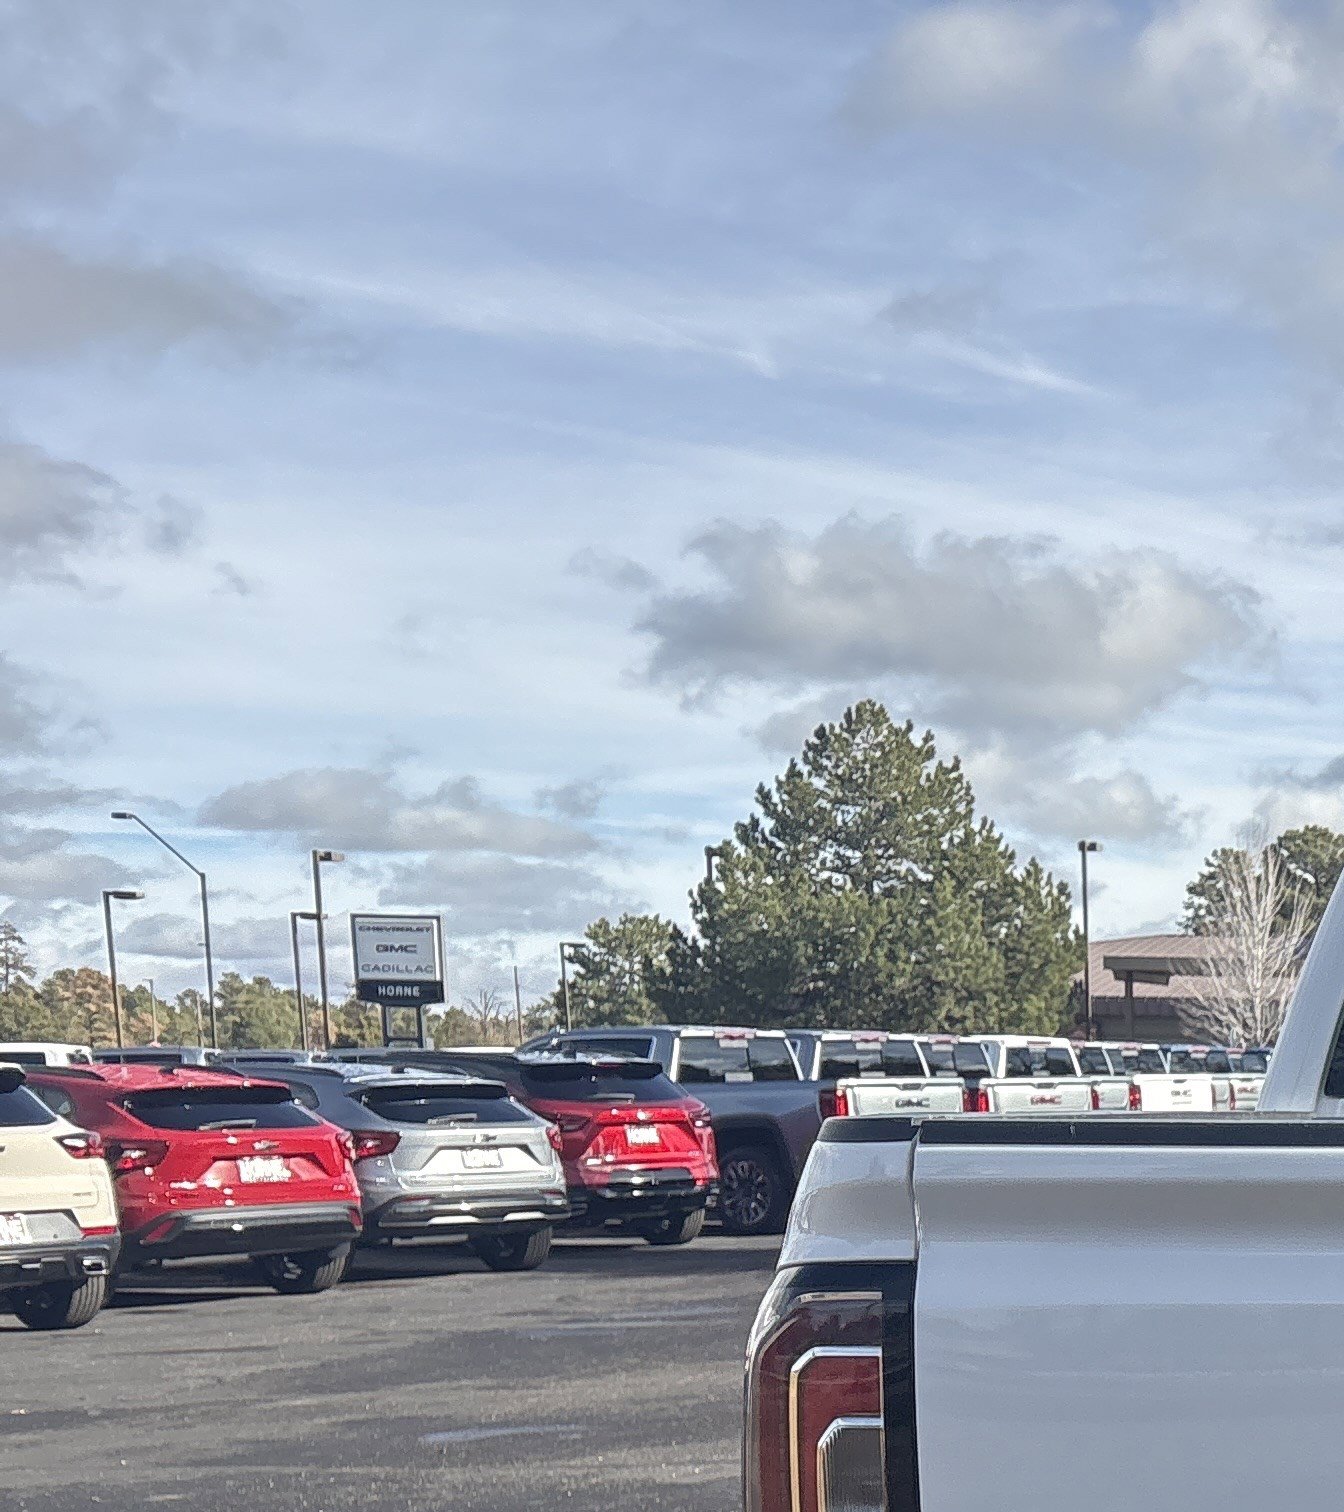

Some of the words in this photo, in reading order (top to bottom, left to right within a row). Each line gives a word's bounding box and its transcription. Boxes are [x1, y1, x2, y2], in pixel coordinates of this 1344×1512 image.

[375, 944, 417, 953] GMC
[361, 963, 434, 974] CADILLAC
[377, 985, 420, 997] HORNE
